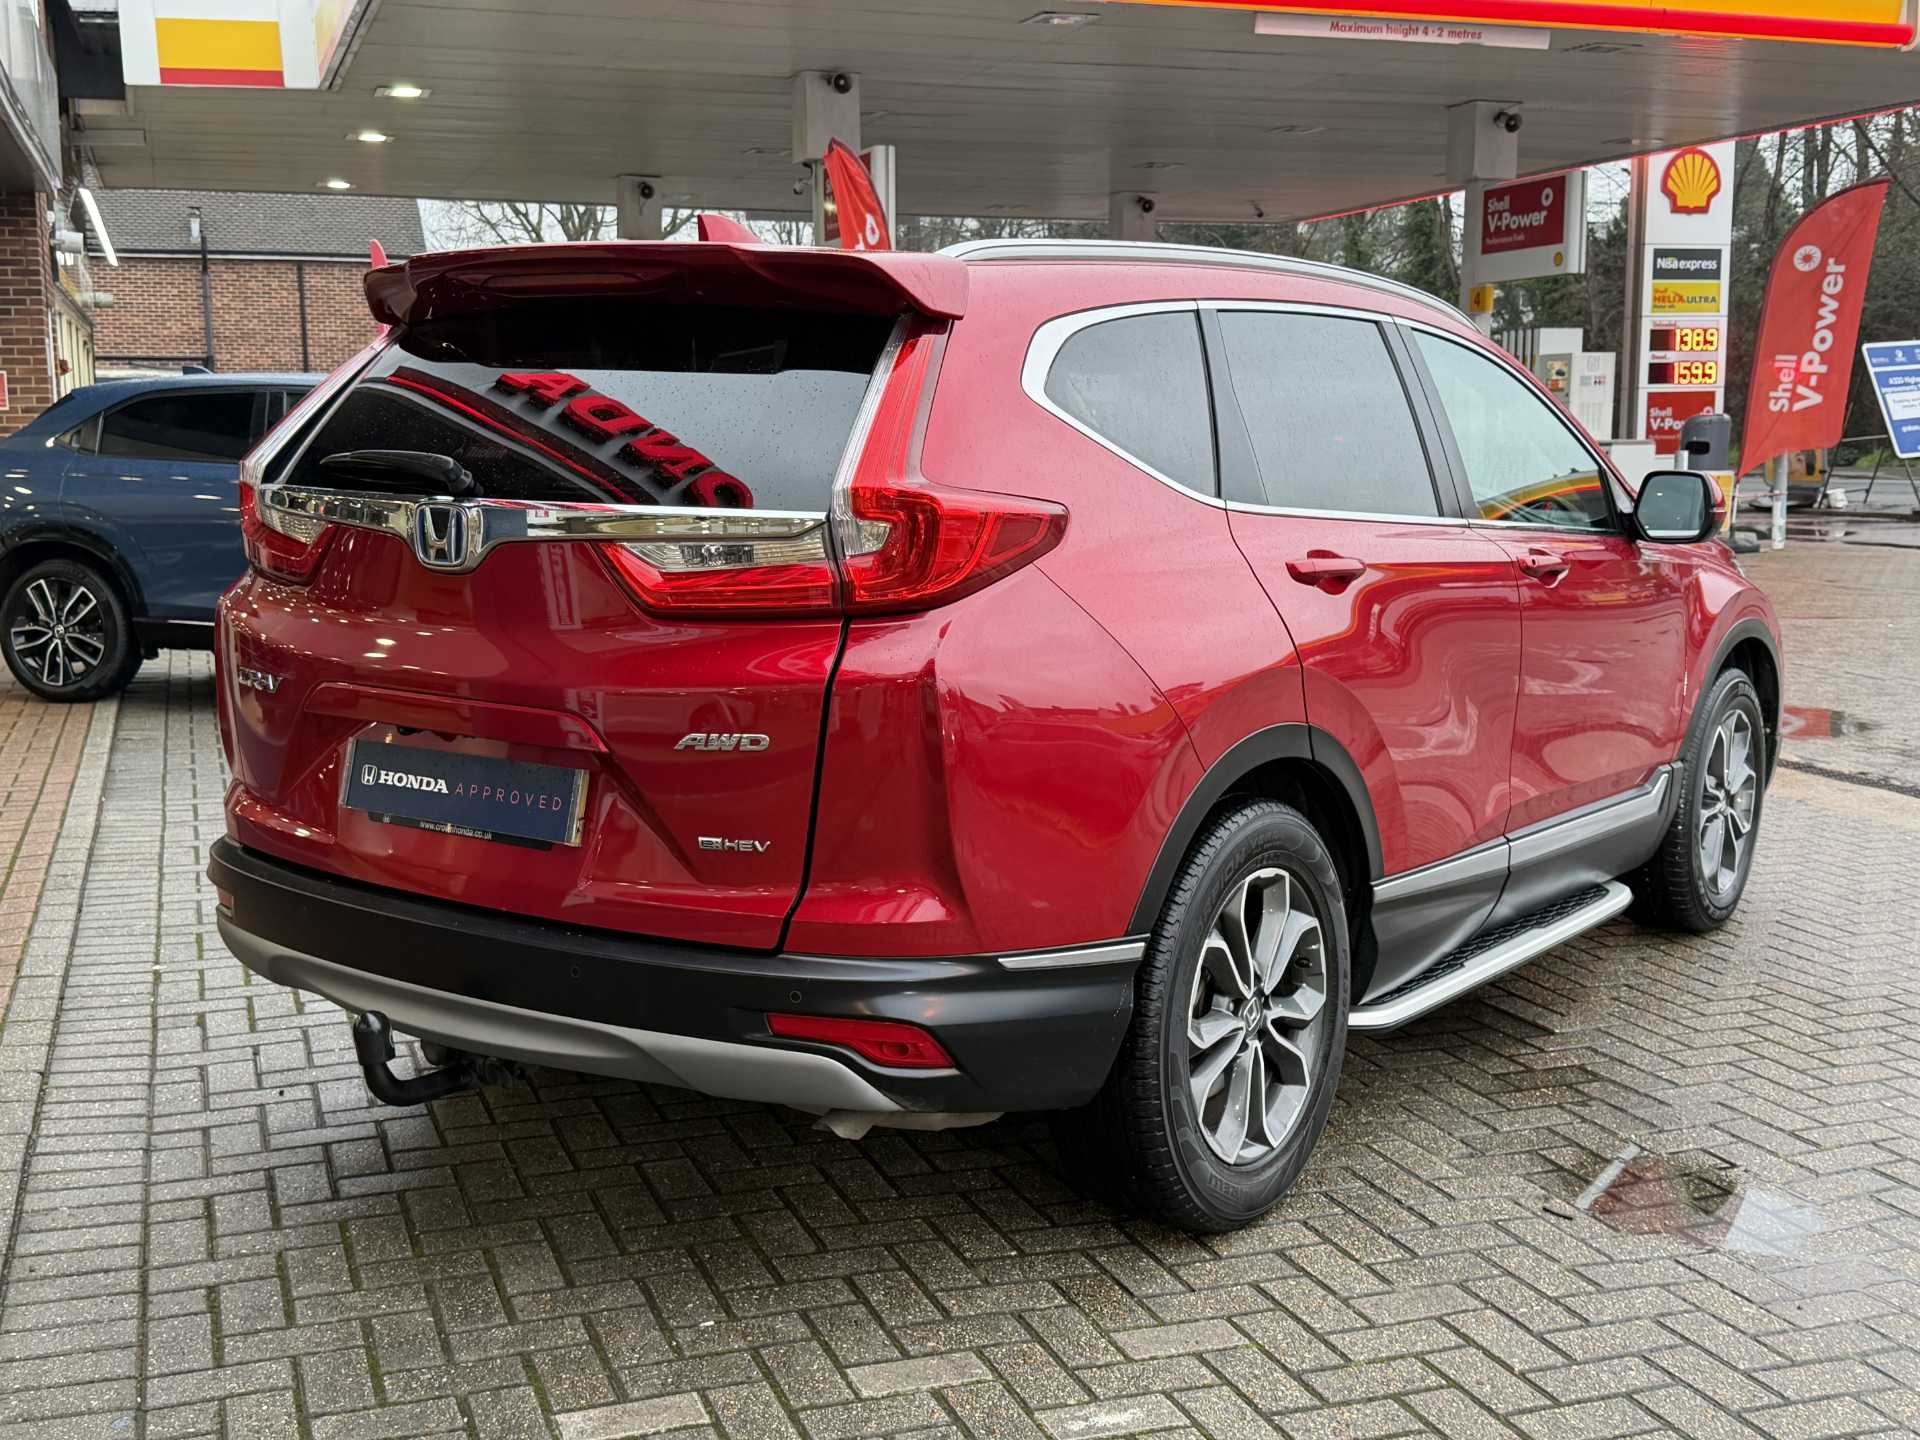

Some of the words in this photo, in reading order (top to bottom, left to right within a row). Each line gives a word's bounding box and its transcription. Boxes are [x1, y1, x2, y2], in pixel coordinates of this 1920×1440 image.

[1330, 21, 1383, 34] Maximum
[1386, 24, 1418, 37] height
[1447, 29, 1483, 40] metres
[1487, 194, 1510, 213] Shell
[1487, 210, 1548, 233] V-Power
[1679, 259, 1718, 272] express
[1675, 328, 1719, 352] 138.9
[1792, 257, 1846, 412] V-Power
[1673, 361, 1717, 384] 159.9
[1768, 354, 1798, 412] Shell
[1650, 407, 1673, 418] Shell
[1650, 418, 1688, 431] V-Po
[673, 732, 770, 751] AWD
[378, 769, 449, 795] HONDA
[455, 782, 562, 811] APPROVED
